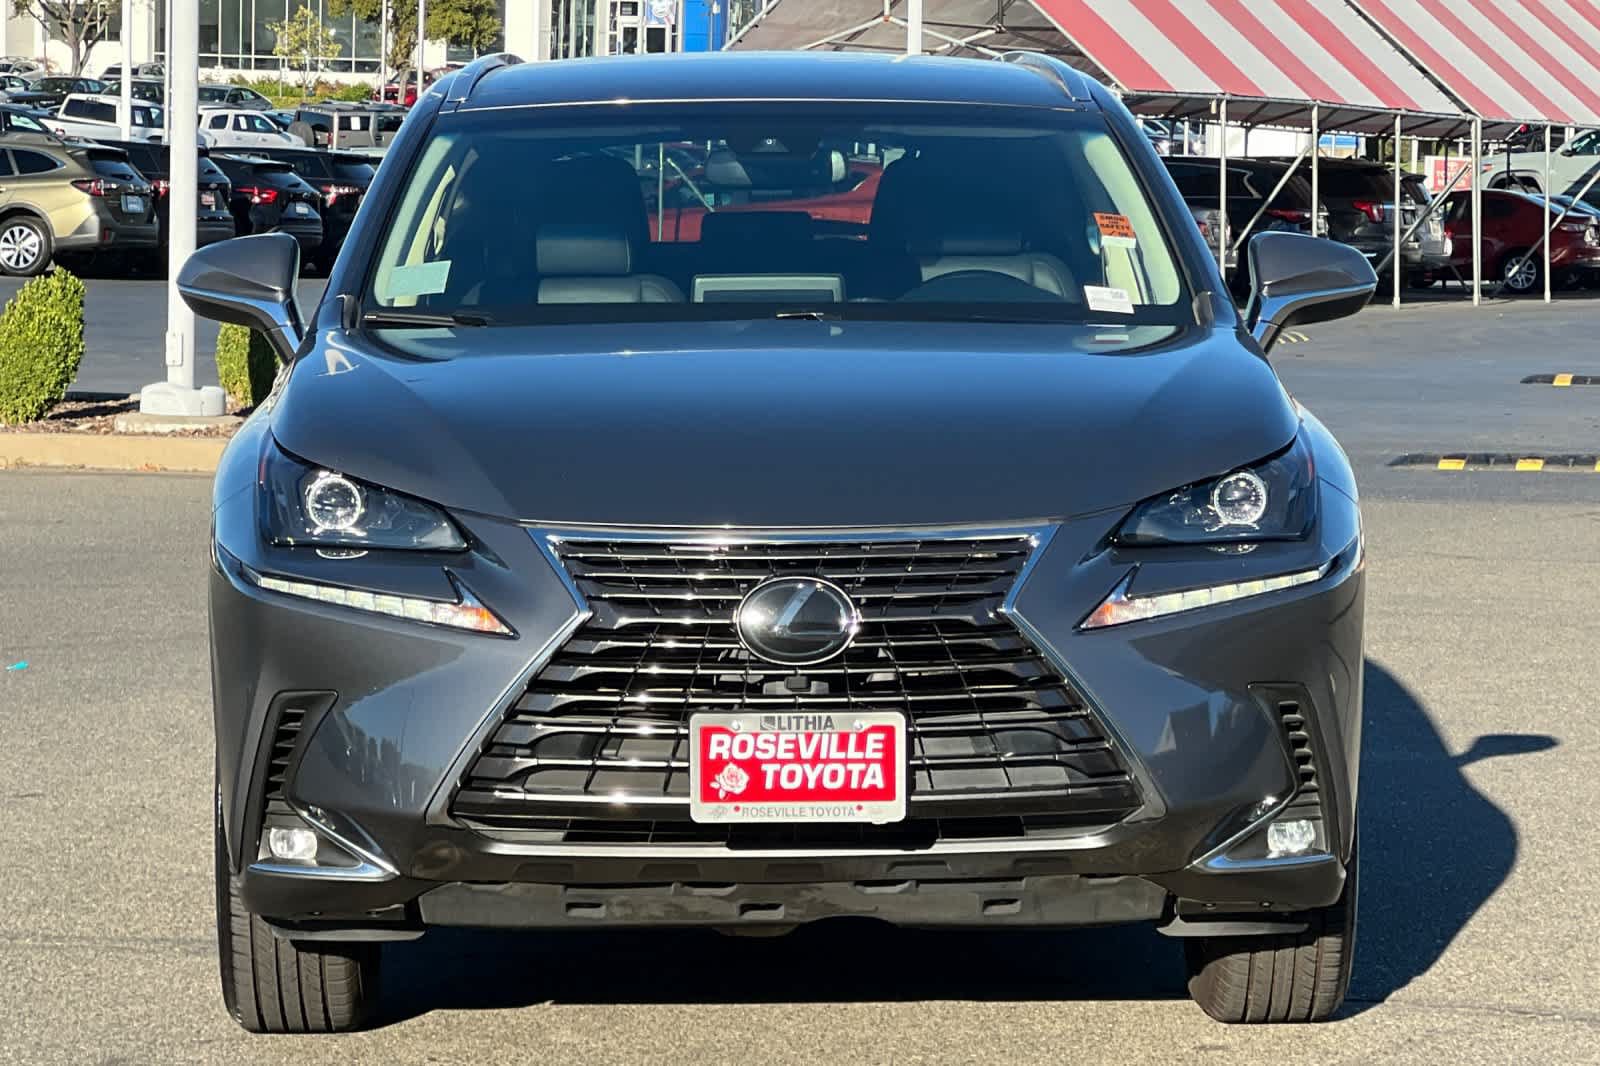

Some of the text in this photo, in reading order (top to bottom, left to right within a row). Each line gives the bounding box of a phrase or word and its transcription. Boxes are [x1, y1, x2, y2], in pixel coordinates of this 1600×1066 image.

[777, 715, 835, 731] LITHIA
[708, 732, 885, 760] ROSEVILLE
[761, 763, 885, 790] TOYOTA
[741, 805, 855, 818] ROSEVILLE TOYOTA
